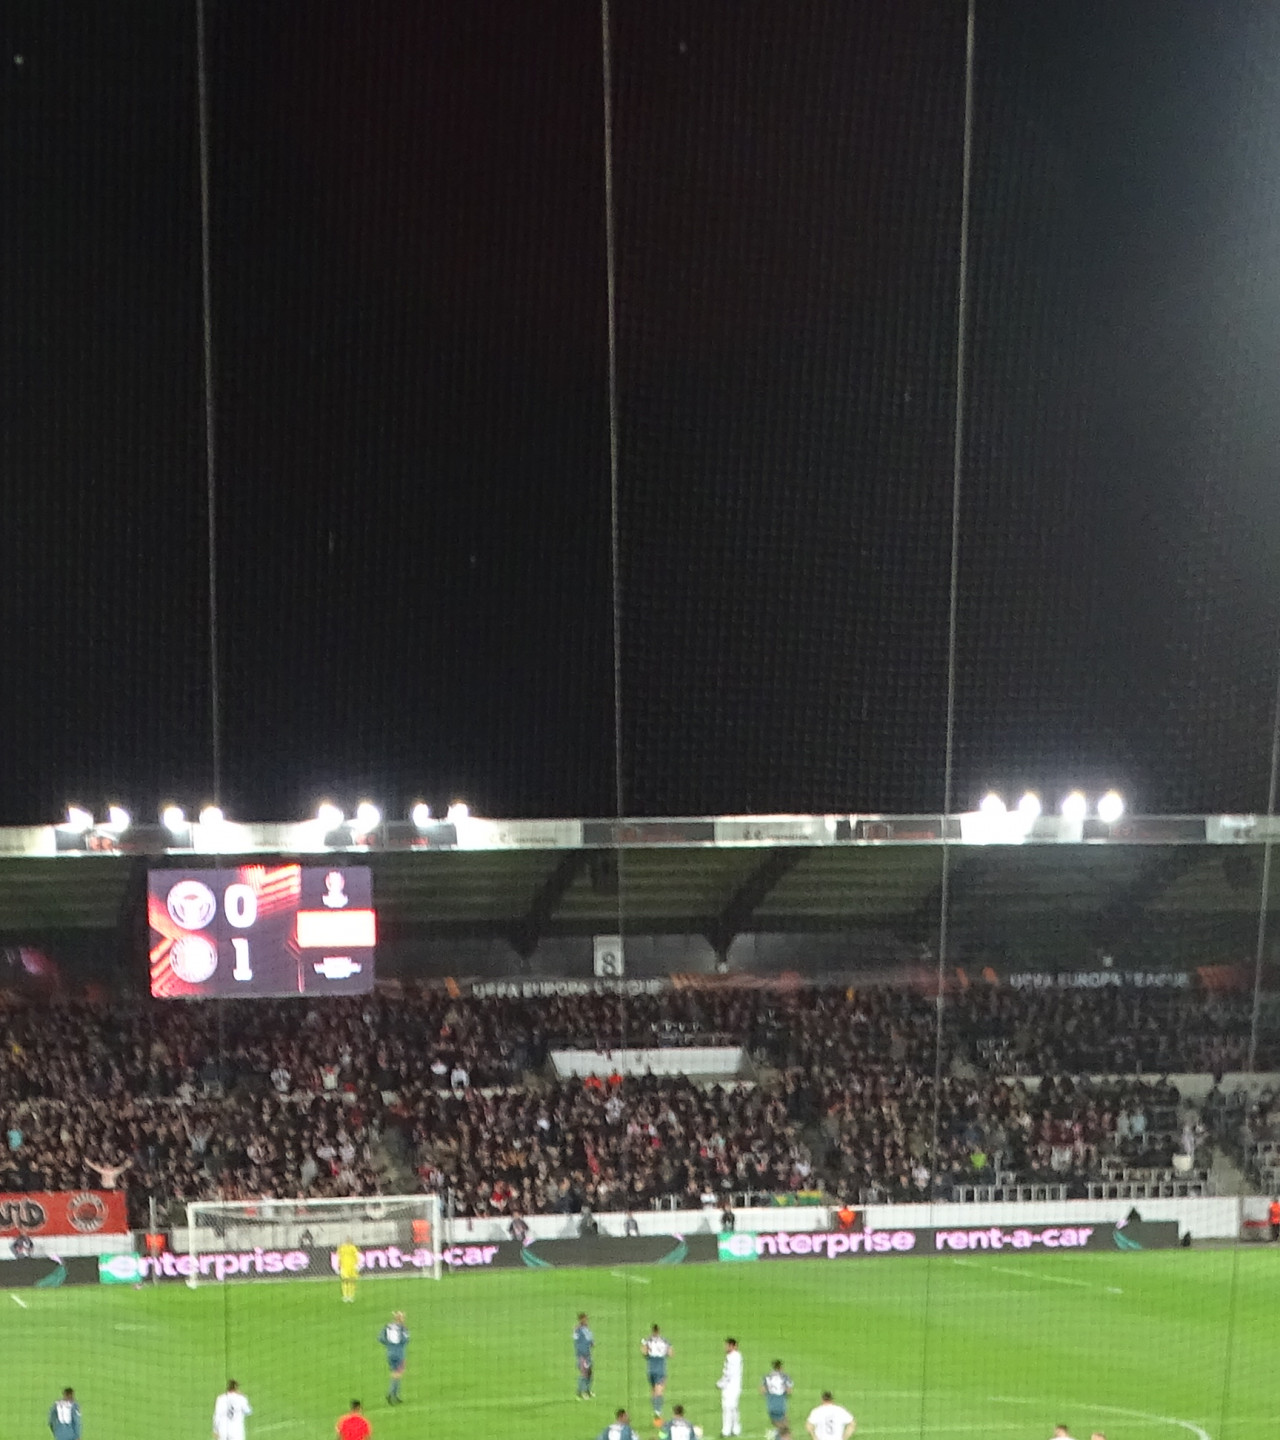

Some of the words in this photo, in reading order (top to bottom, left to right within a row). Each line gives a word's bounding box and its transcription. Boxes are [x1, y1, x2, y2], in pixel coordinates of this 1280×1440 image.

[224, 883, 258, 928] 0
[230, 937, 253, 981] 1
[727, 1226, 917, 1260] enterprise
[935, 1226, 1094, 1250] rent-a-car
[108, 1246, 310, 1281] enterprise
